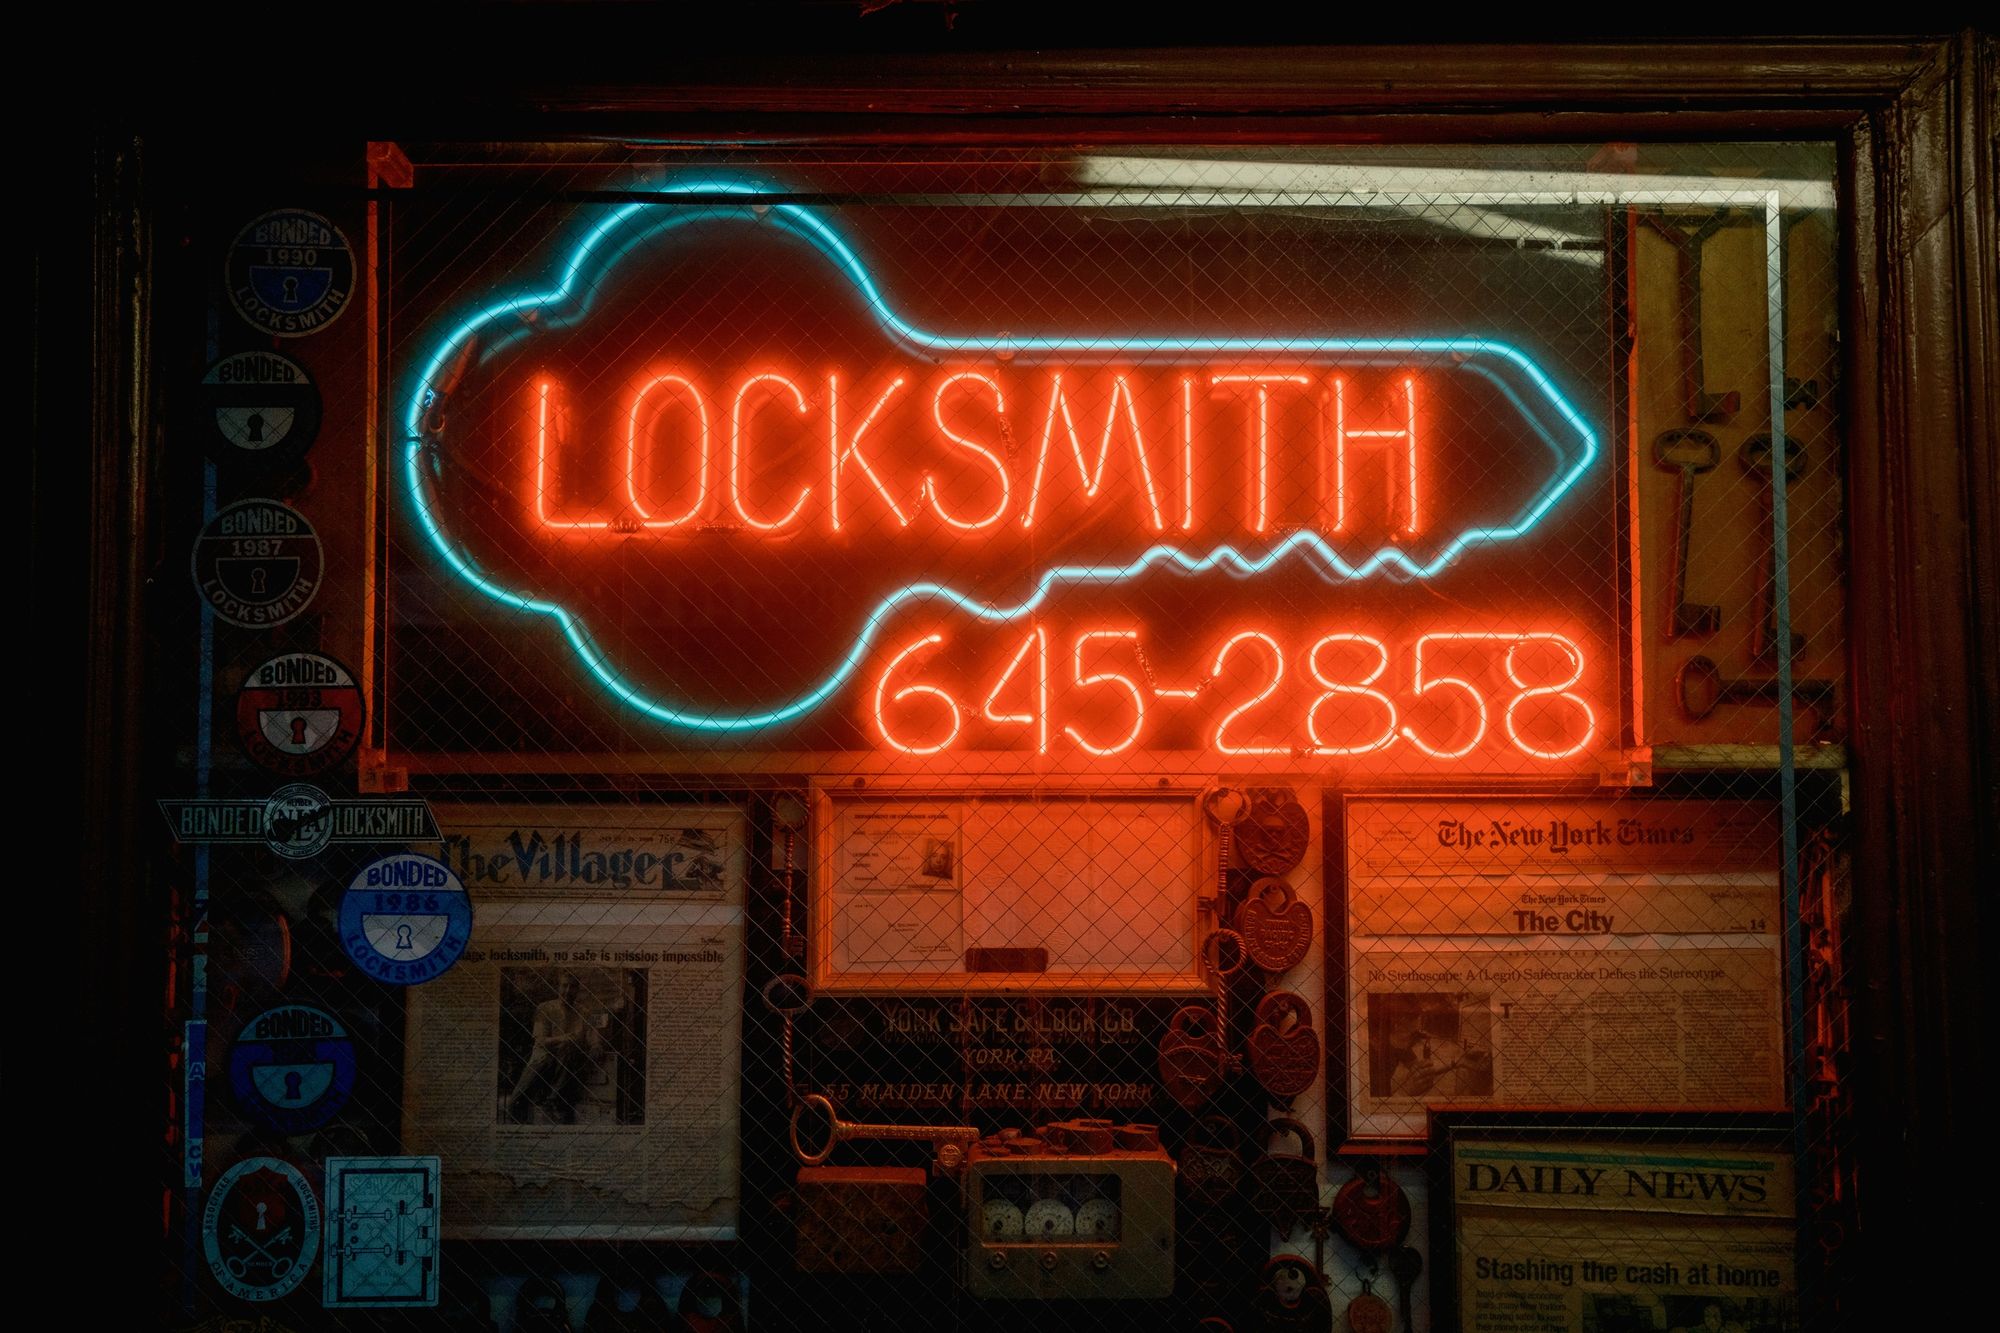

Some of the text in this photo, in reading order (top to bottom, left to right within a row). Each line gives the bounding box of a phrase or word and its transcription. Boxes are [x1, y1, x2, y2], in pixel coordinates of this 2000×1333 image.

[255, 218, 332, 245] BONDED
[264, 249, 318, 265] 1990
[235, 286, 345, 331] LOCKSMITH
[219, 356, 296, 382] BONDED
[533, 371, 1420, 534] LOCKSMITH
[221, 507, 298, 534] BONDED
[232, 539, 284, 557] 1987
[202, 576, 314, 622] LOCKSMITH
[260, 658, 337, 685] BONDED
[874, 628, 1597, 760] 645-2858
[286, 798, 313, 807] MEMBER
[181, 806, 424, 836] BONDED LOCKSMITH
[1437, 819, 1485, 851] The
[1489, 820, 1544, 849] New
[1549, 819, 1613, 855] York
[1616, 818, 1696, 847] Times
[366, 860, 448, 887] BONDED
[505, 829, 685, 891] Villager
[375, 893, 440, 913] 1986
[1521, 893, 1606, 906] The New York Times
[1512, 908, 1615, 935] The City
[1750, 918, 1766, 930] 14
[350, 934, 463, 982] LOCKSMITH
[489, 948, 550, 963] locksmith,
[554, 951, 569, 963] no
[572, 949, 597, 963] safe
[600, 950, 611, 963] is
[614, 950, 659, 963] mission
[661, 950, 725, 966] impossible
[1368, 967, 1726, 984] No Stethoscope: A (Legit) Safecracker Defies the Stereotype
[255, 1008, 334, 1038] BONDED
[884, 1005, 942, 1033] YORK
[950, 1003, 1010, 1033] SAFE
[1014, 1003, 1031, 1033] &
[1038, 1005, 1096, 1033] LOCK
[1027, 1048, 1062, 1066] PA.
[861, 1083, 955, 1101] MAIDEN
[1038, 1083, 1088, 1101] NEW
[1464, 1162, 1768, 1203] DAILY NEWS
[204, 1176, 319, 1232] ASSOCIATED LOCKSMITHS
[211, 1259, 308, 1300] OF AMERICA
[1475, 1256, 1780, 1289] Stashing the cash at home
